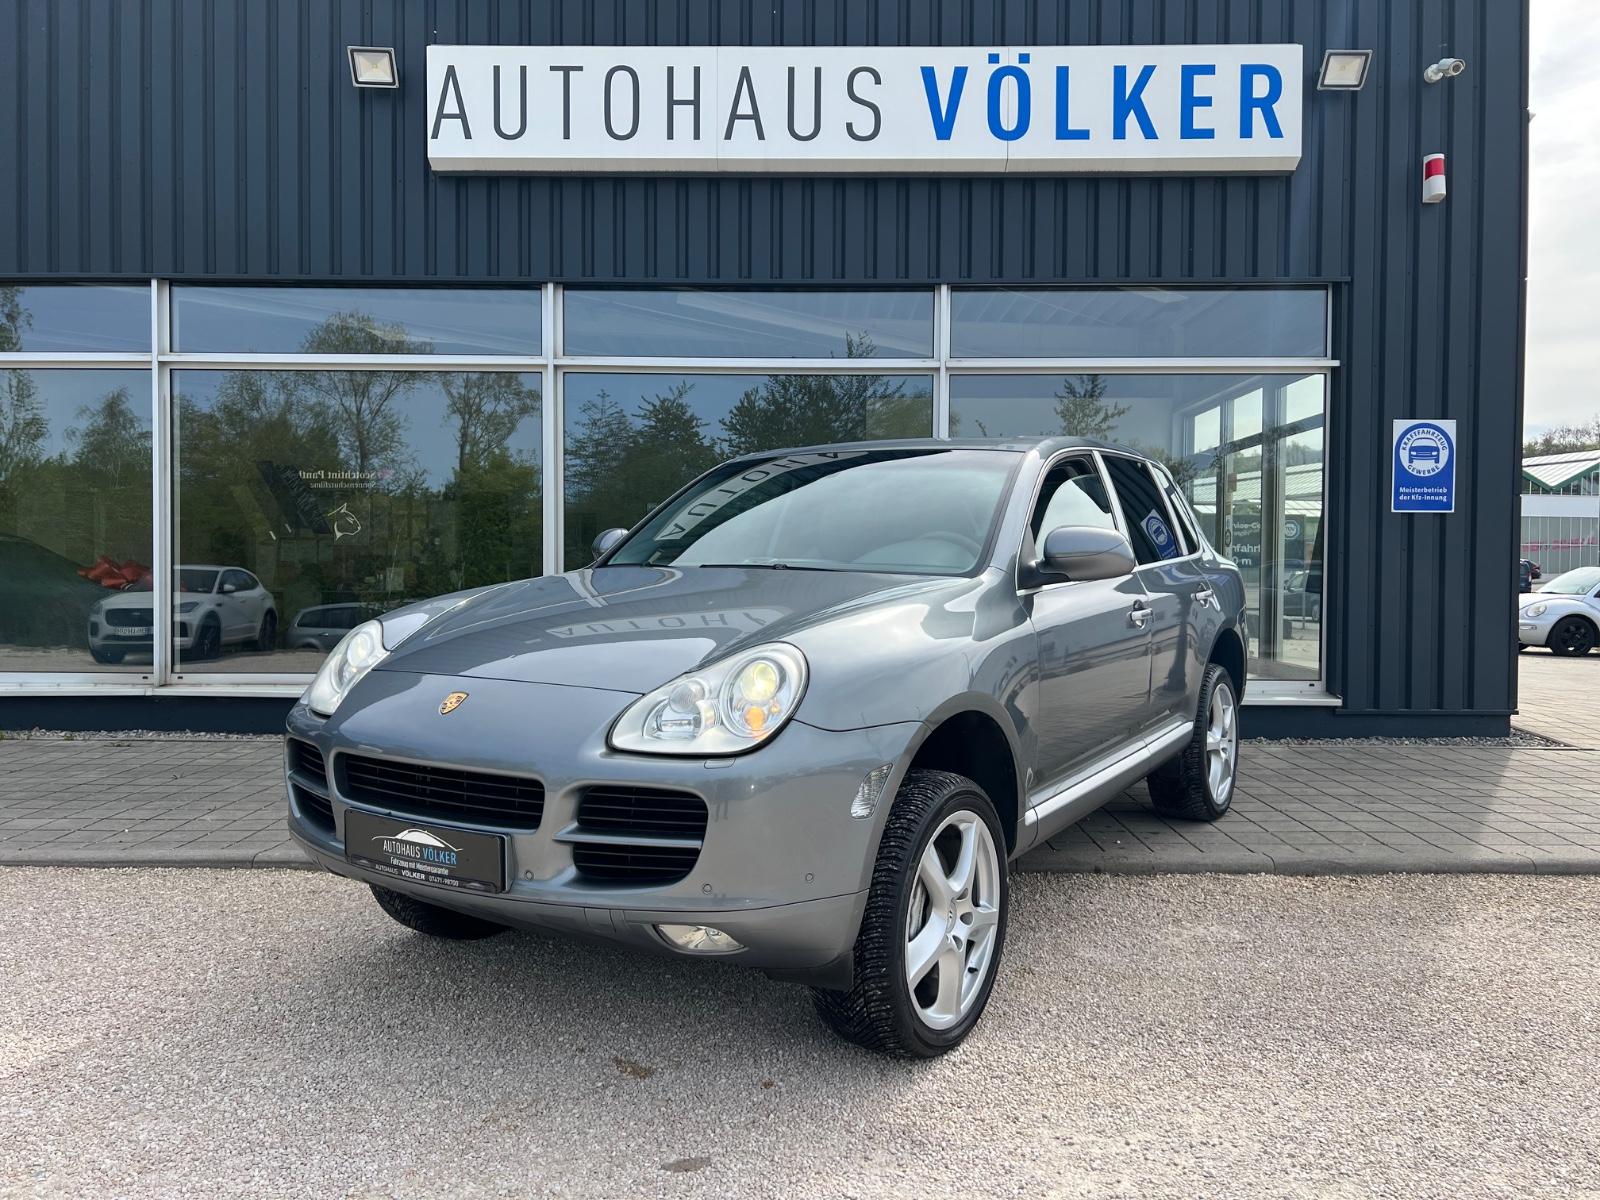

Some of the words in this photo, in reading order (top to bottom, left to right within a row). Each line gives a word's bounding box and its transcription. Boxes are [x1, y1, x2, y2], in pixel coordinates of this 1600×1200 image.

[429, 65, 881, 141] AUTOHAUS
[921, 52, 1284, 140] VÖLKER
[1401, 429, 1448, 451] KRAFTFAHRZEUG
[1407, 464, 1441, 475] GEWERBE
[1411, 494, 1447, 502] Kfz-Innung
[383, 839, 421, 858] AUTOHAUS
[375, 864, 399, 875] AUTOHAUS
